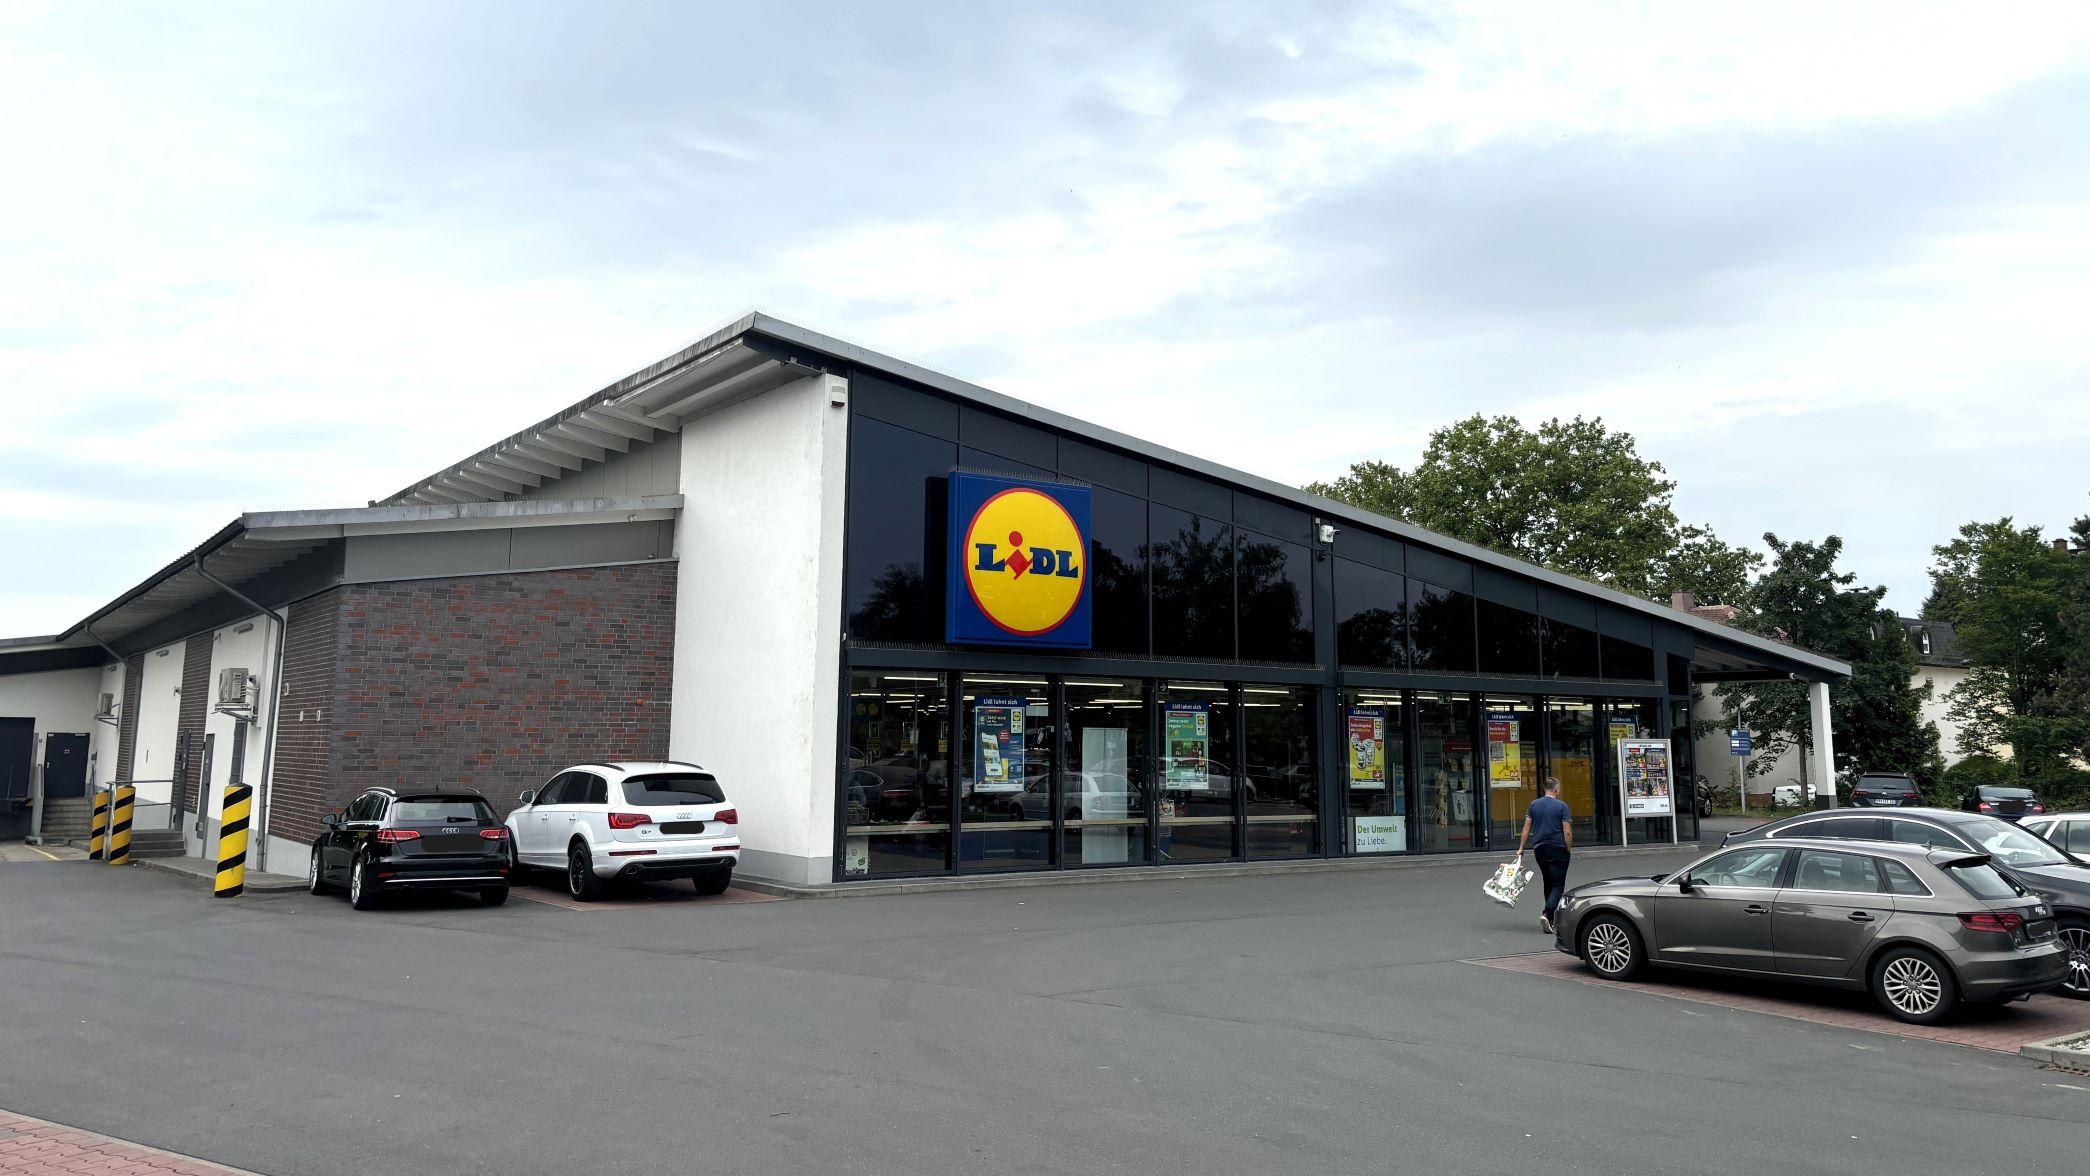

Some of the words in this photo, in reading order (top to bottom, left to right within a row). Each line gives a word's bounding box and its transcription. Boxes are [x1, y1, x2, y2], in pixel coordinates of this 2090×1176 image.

[1357, 825, 1370, 834] Der
[1371, 823, 1398, 834] Umwelt
[1357, 838, 1366, 846] zu
